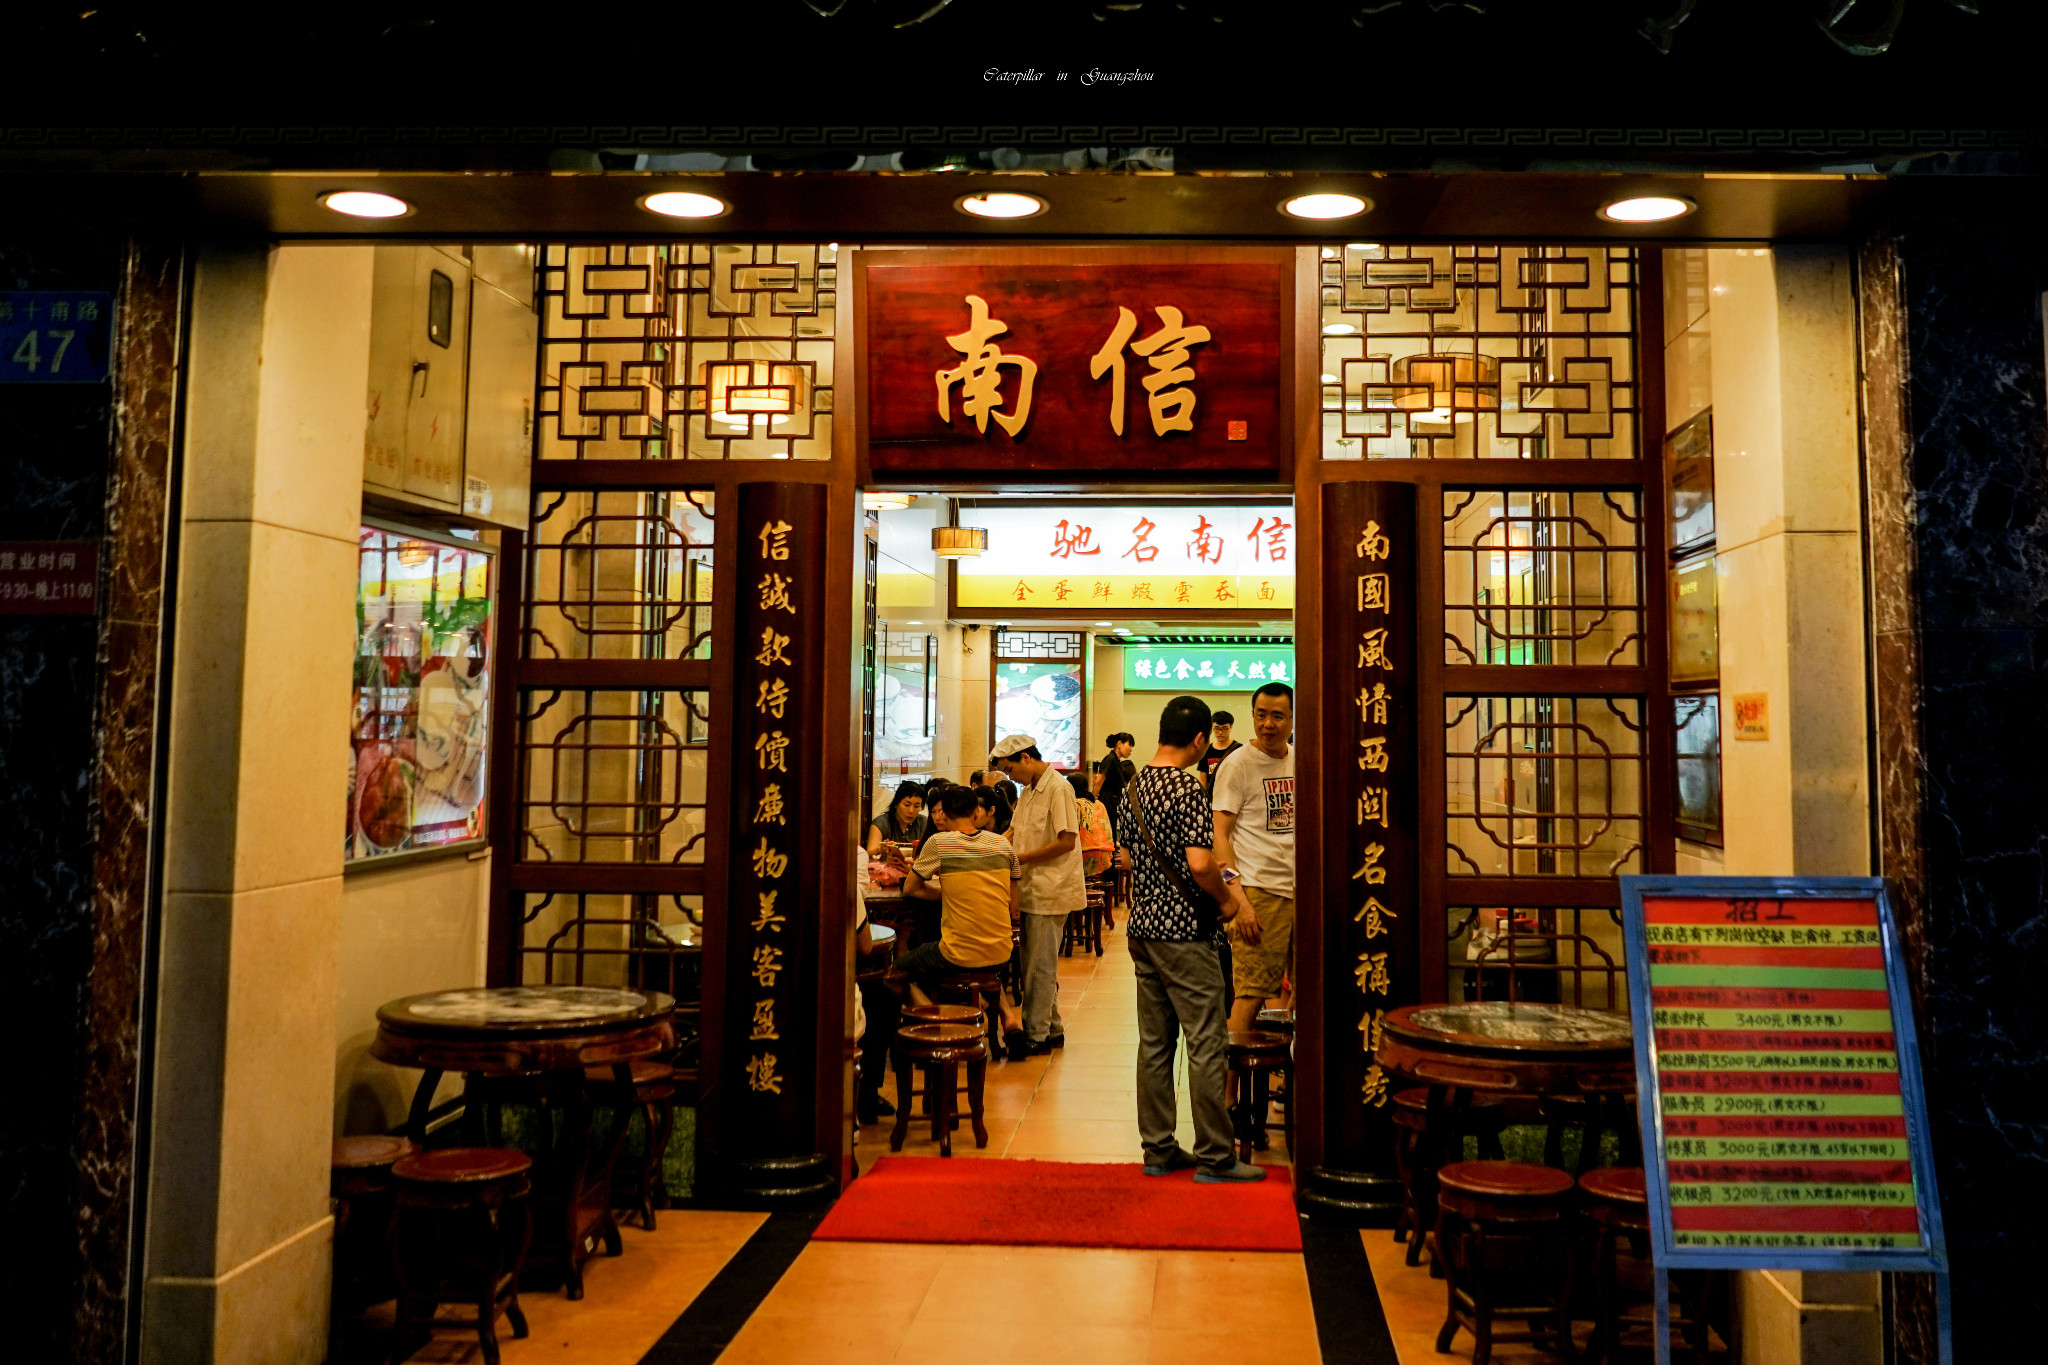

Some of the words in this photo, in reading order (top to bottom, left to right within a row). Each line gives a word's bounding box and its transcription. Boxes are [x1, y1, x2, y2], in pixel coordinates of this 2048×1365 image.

[12, 329, 76, 374] 47
[935, 294, 1211, 437] 南信
[0, 551, 77, 571] 营业时间
[1663, 1094, 1706, 1113] 服务员
